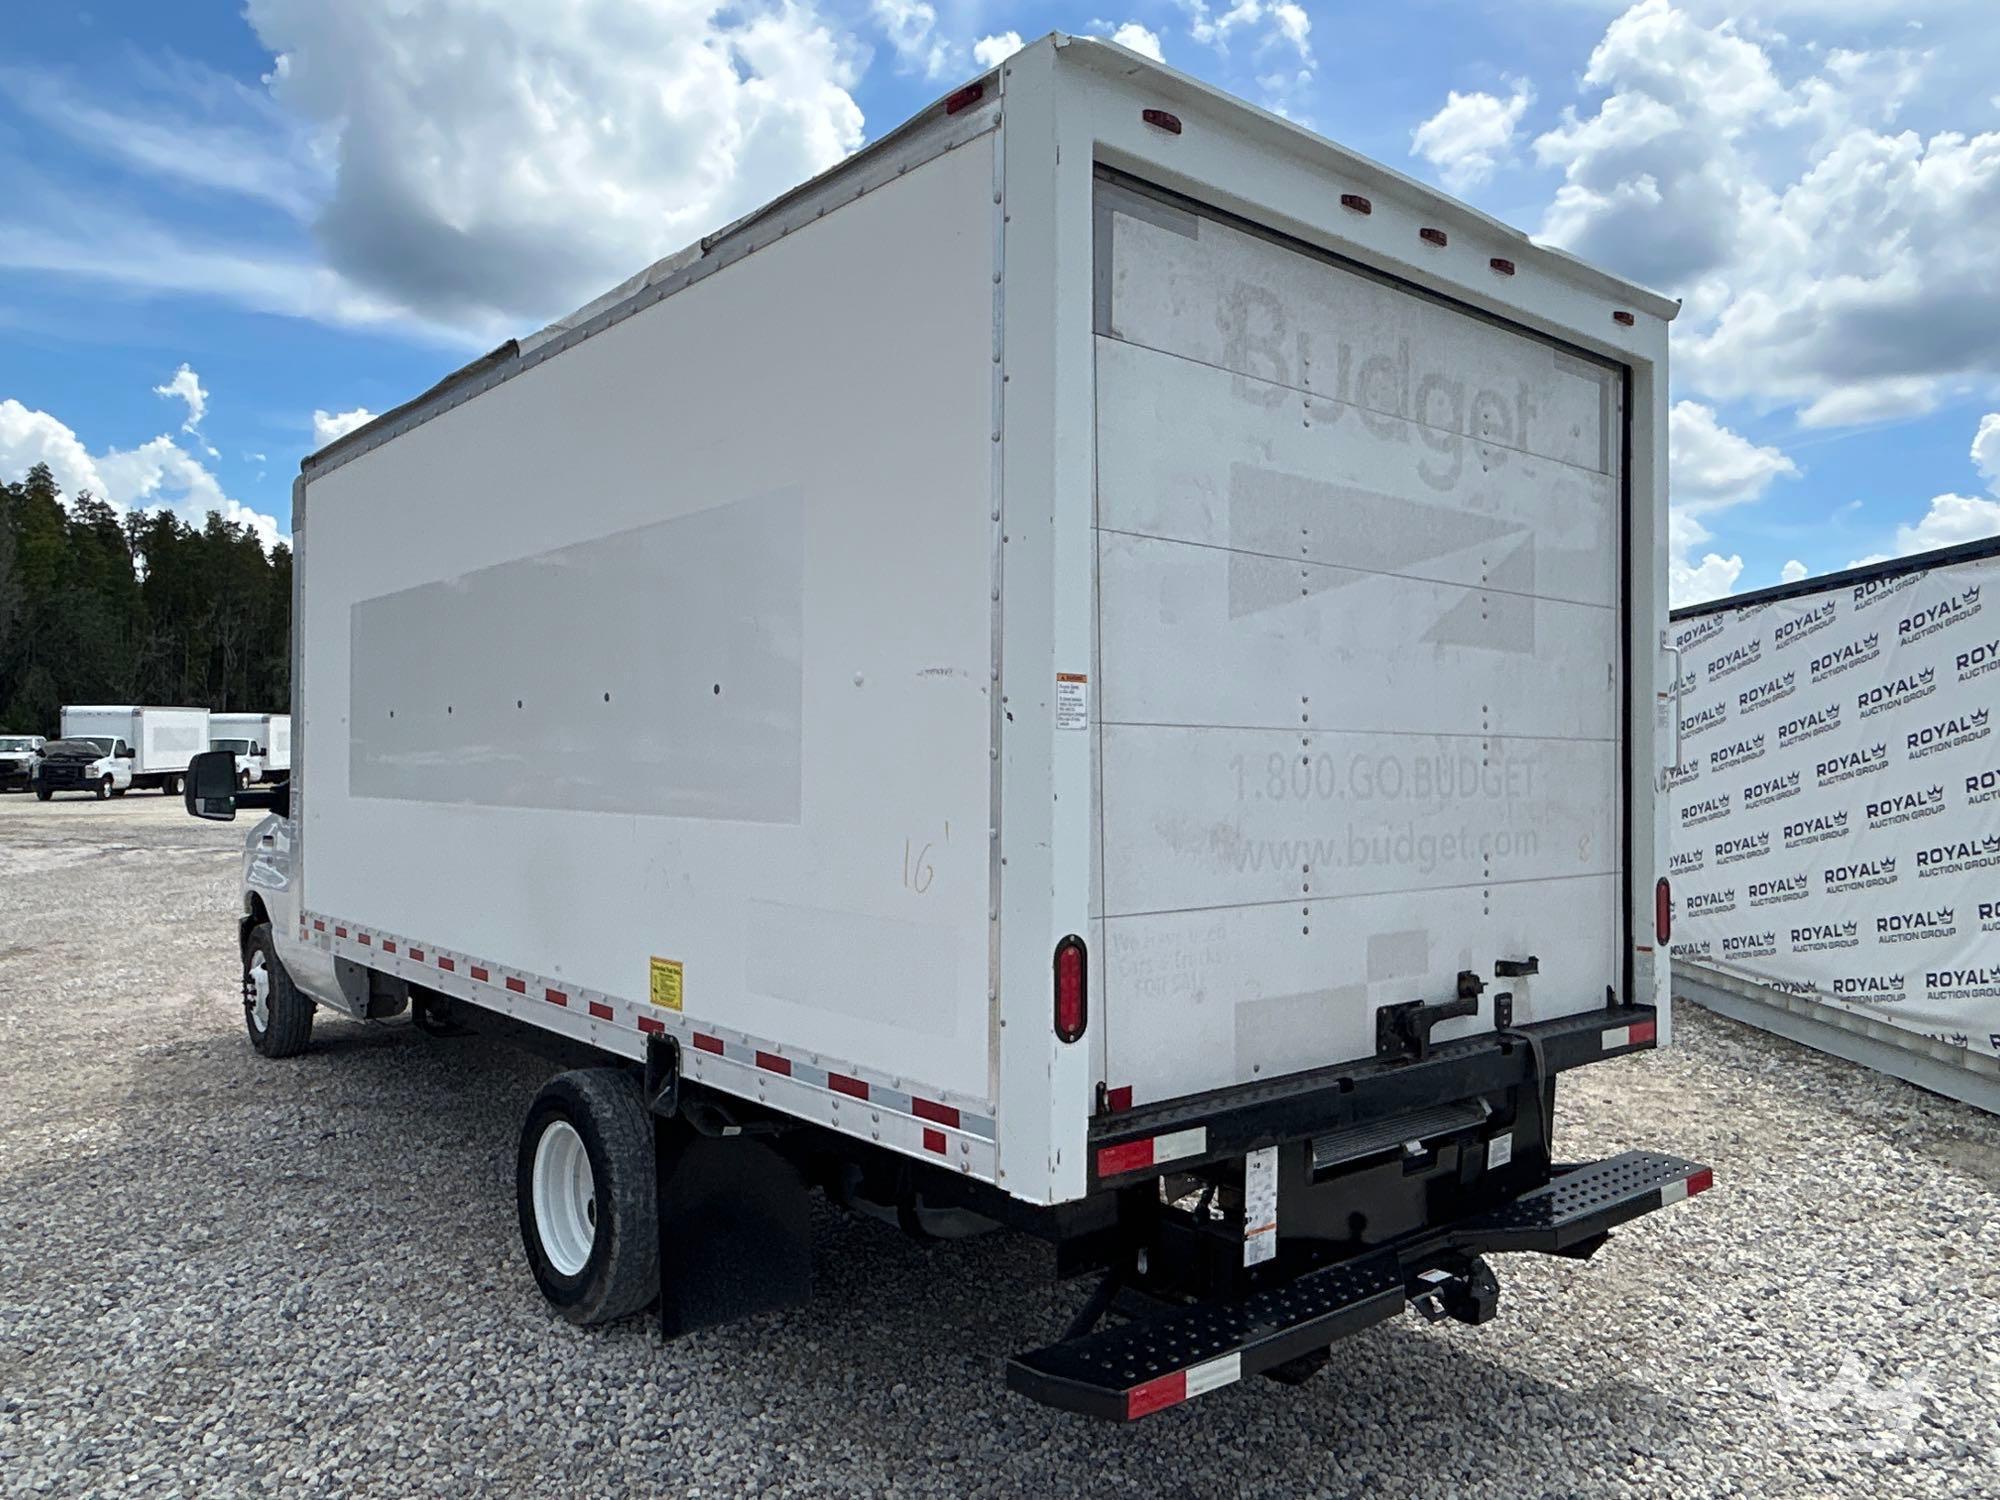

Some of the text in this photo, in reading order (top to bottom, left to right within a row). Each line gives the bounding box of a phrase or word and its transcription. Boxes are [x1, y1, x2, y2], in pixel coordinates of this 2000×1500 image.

[1226, 281, 1536, 491] Budget
[1854, 569, 1929, 612] AUCTION GROUP
[1775, 609, 1822, 641] ROYAL
[1898, 597, 1962, 635] ROYAL
[1900, 604, 1981, 647] AUCTION GROUP
[1676, 620, 1713, 647] ROYAL
[1776, 616, 1836, 650] AUCTION GROUP
[1708, 646, 1748, 674] ROYAL
[1810, 641, 1864, 674] ROYAL
[1812, 650, 1880, 684] AUCTION GROUP
[1956, 640, 2000, 670] ROY
[1958, 658, 2000, 683] AUCTIO
[1739, 678, 1783, 706] ROYAL
[1857, 675, 1918, 708] ROYAL
[1859, 685, 1936, 719] AUCTION GROUP
[1778, 711, 1827, 739] ROYAL
[1779, 720, 1841, 749] AUCTION GROUP
[1907, 716, 1971, 749] ROYAL
[1710, 741, 1753, 764] ROYAL
[1908, 727, 1991, 760] AUCTION GROUP
[1816, 750, 1871, 777] ROYAL
[1818, 760, 1889, 787] AUCTION GROUP
[1744, 777, 1788, 800] ROYAL
[1968, 790, 2000, 805] AUCT
[1681, 799, 1719, 819] ROYAL
[1866, 792, 1927, 818] ROYAL
[1869, 804, 1946, 830] AUCTION GROUP
[1783, 816, 1833, 839] ROYAL
[1785, 828, 1849, 849] AUCTION GROUP
[1715, 836, 1757, 856] ROYAL
[1917, 841, 1982, 866] ROYAL
[1825, 861, 1881, 883] ROYAL
[1918, 862, 1963, 878] AUCTION
[1749, 878, 1794, 897] ROYAL
[1826, 875, 1898, 894] AUCTION GROUP
[1687, 892, 1724, 908] ROYAL
[1791, 924, 1843, 942] ROYAL
[1877, 912, 1937, 932] ROYAL
[1722, 935, 1764, 950] ROYAL
[1792, 939, 1859, 953] AUCTION GROUP
[1878, 927, 1956, 944] AUCTION GROUP
[1834, 977, 1889, 993] ROYAL
[1926, 968, 1989, 988] ROYAL
[1927, 987, 2000, 1000] AUCTION GROU
